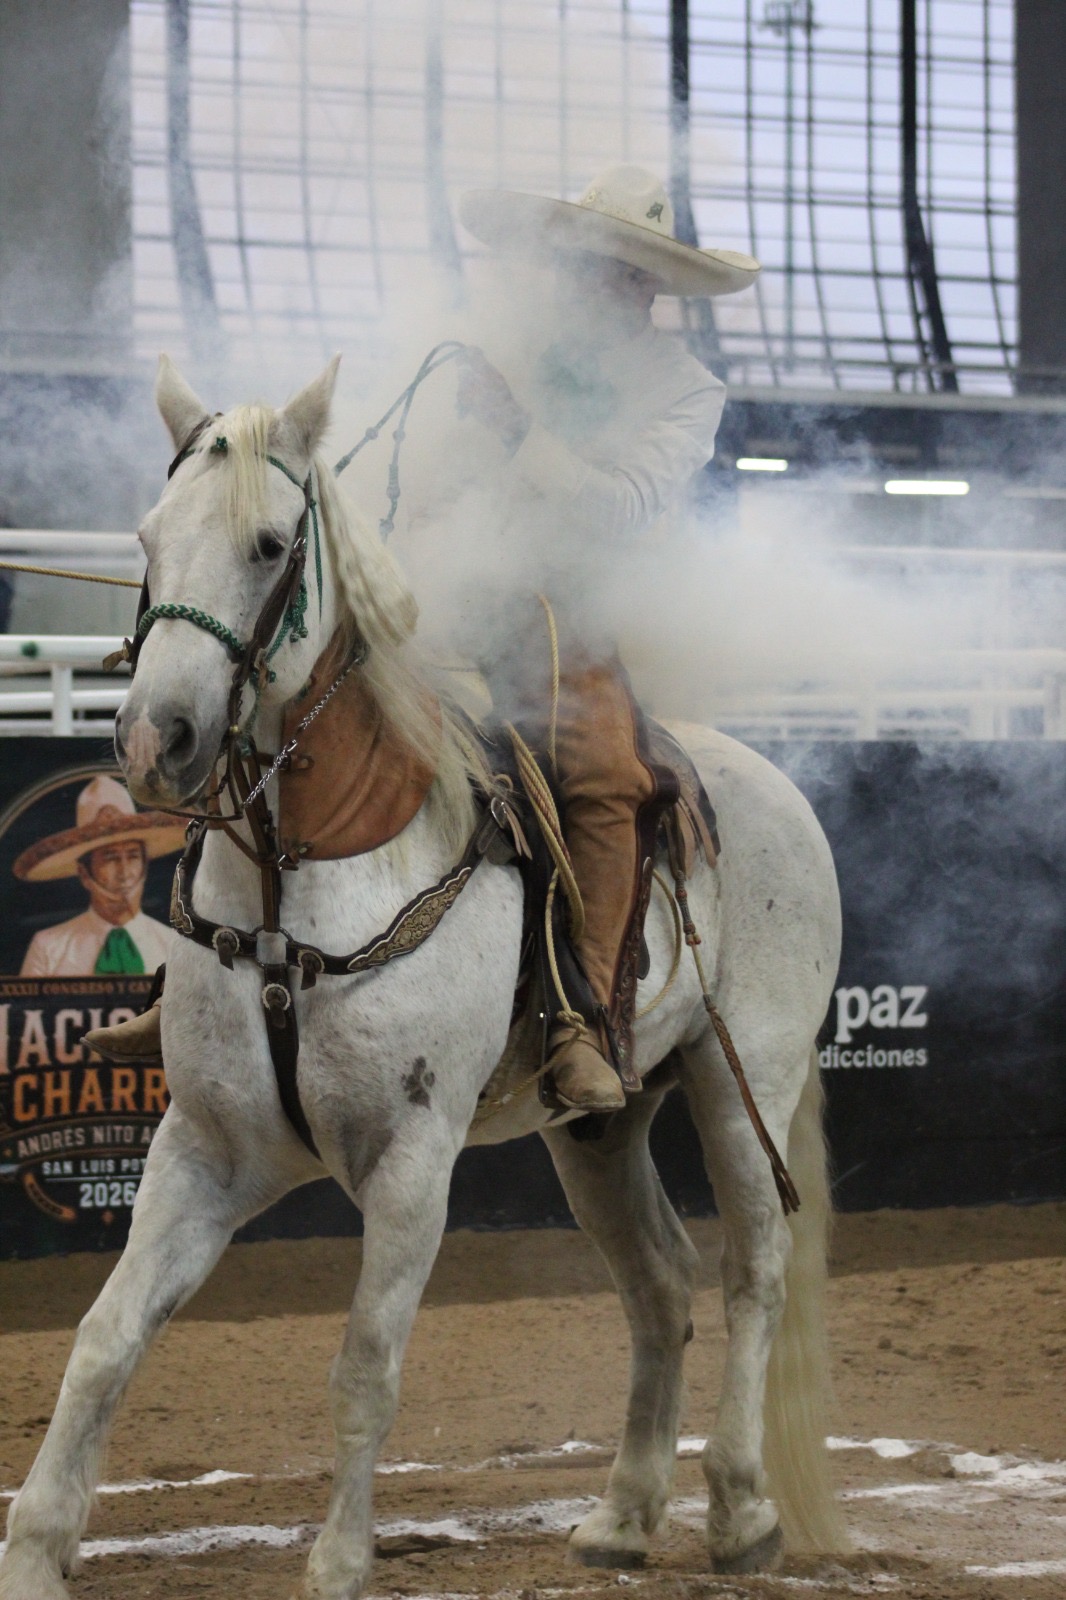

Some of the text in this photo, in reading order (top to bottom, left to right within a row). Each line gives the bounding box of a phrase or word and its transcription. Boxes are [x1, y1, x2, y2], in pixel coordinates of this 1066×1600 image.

[835, 985, 928, 1042] paz
[819, 1045, 928, 1069] dicciones
[13, 1067, 169, 1122] CHARR
[42, 1160, 73, 1175] SAN
[80, 1159, 115, 1174] LUIS
[79, 1181, 136, 1208] 2026
